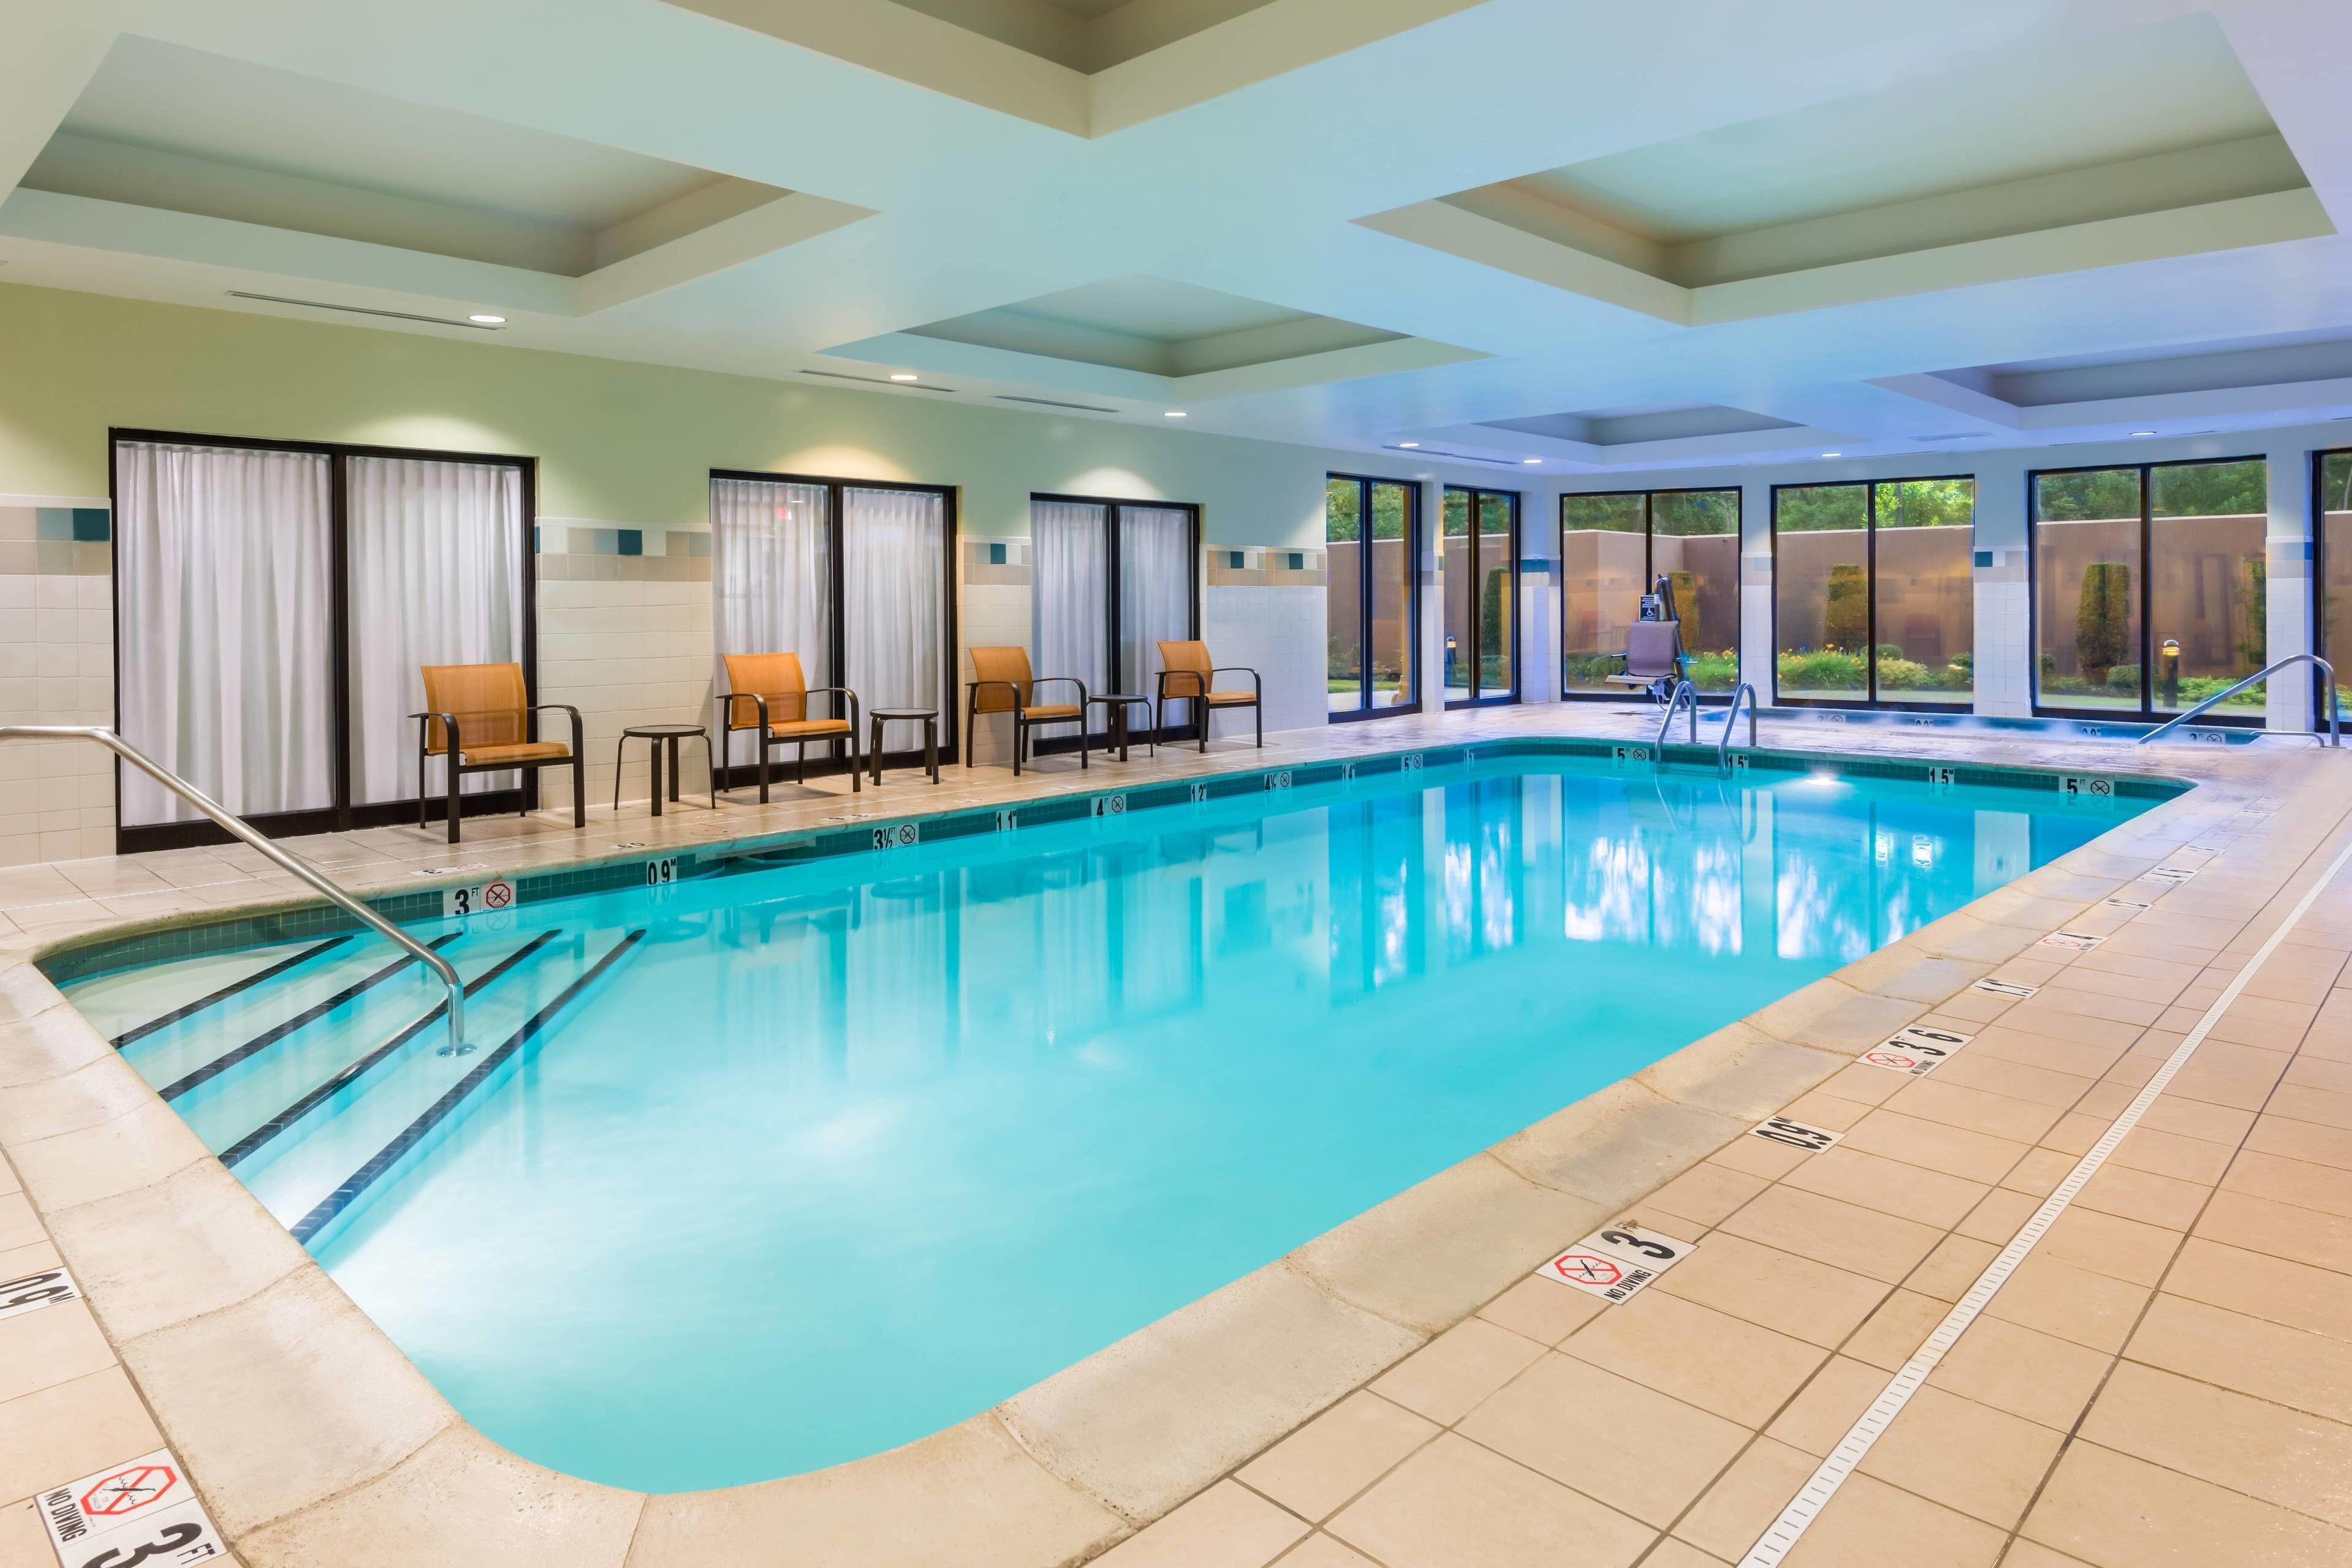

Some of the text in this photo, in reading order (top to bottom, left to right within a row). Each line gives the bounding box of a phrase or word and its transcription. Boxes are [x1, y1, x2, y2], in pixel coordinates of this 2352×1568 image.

[2067, 778, 2078, 793] 5
[1097, 799, 1104, 815] 4
[455, 888, 480, 915] 3 FT
[1601, 1231, 1675, 1259] 3
[1604, 1269, 1653, 1300] NO DIVING
[45, 1488, 87, 1542] NO DIVING
[81, 1523, 216, 1568] 3 FT
